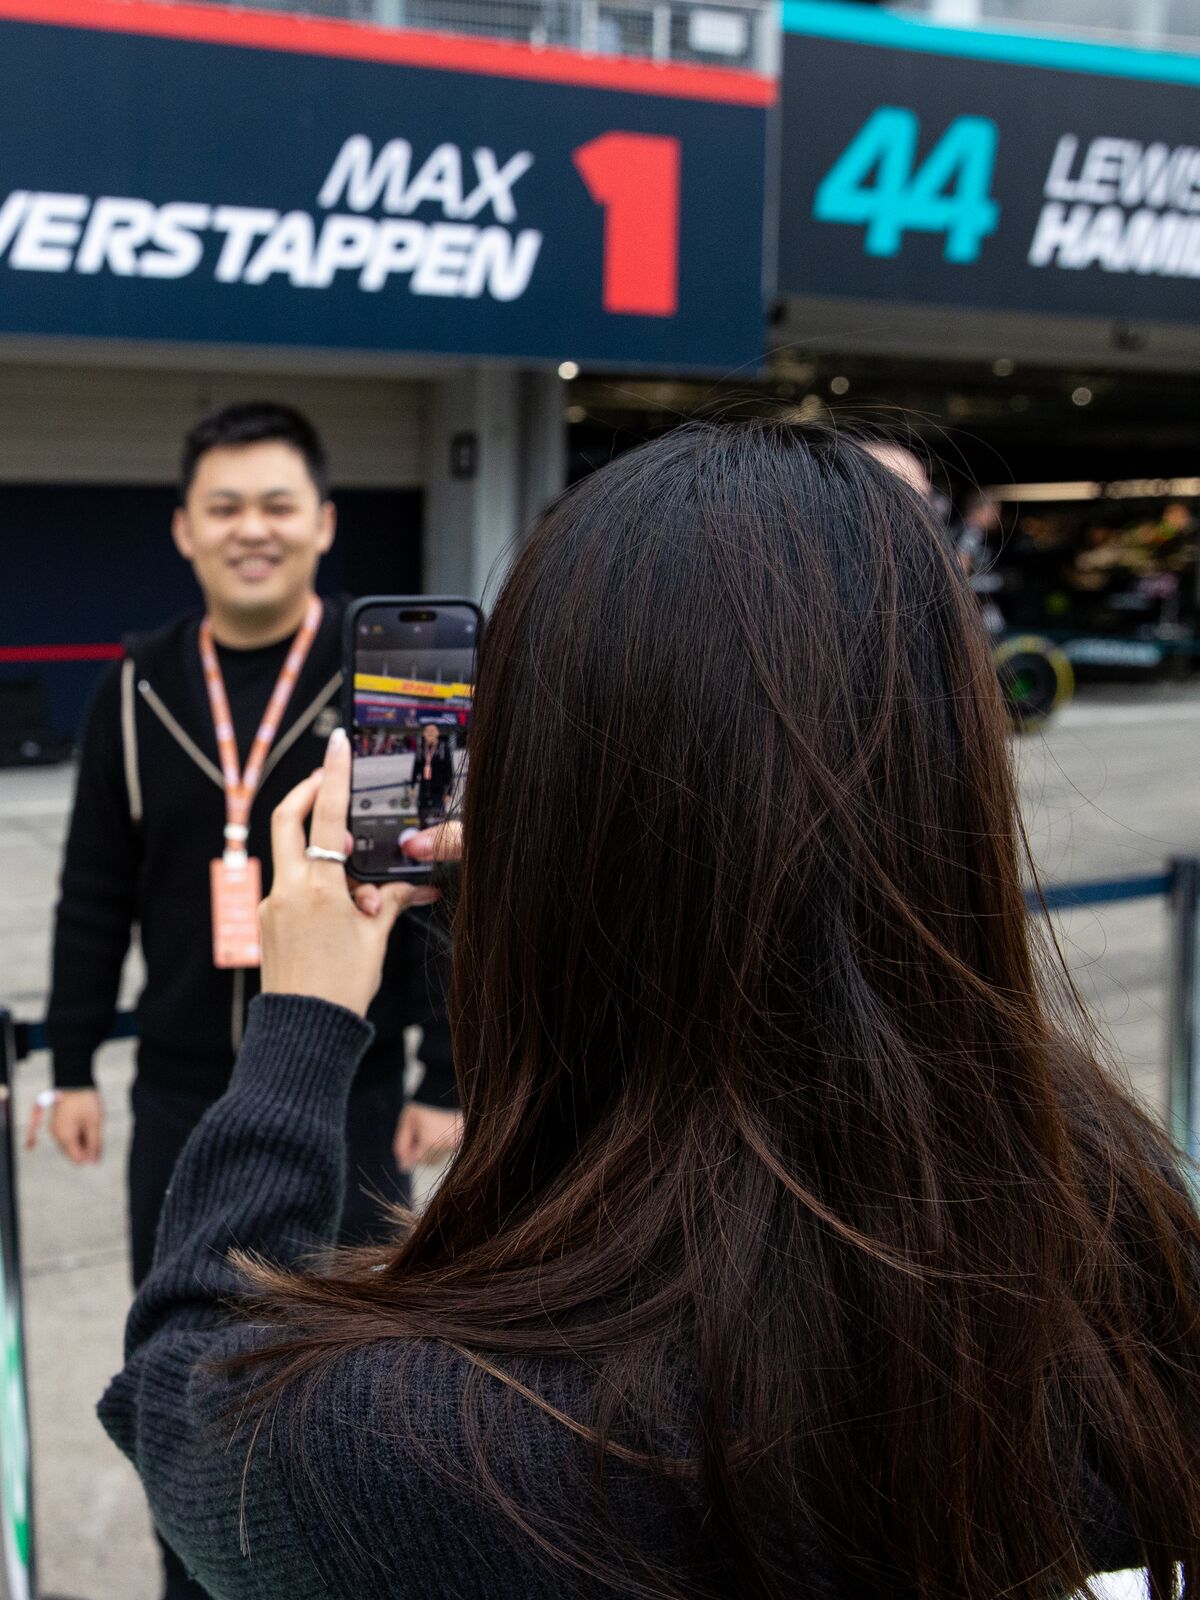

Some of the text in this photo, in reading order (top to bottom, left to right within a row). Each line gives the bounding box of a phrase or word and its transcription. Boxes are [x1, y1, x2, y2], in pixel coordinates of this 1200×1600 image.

[318, 134, 535, 223] MAX
[572, 131, 681, 317] 1
[812, 105, 1001, 265] 44
